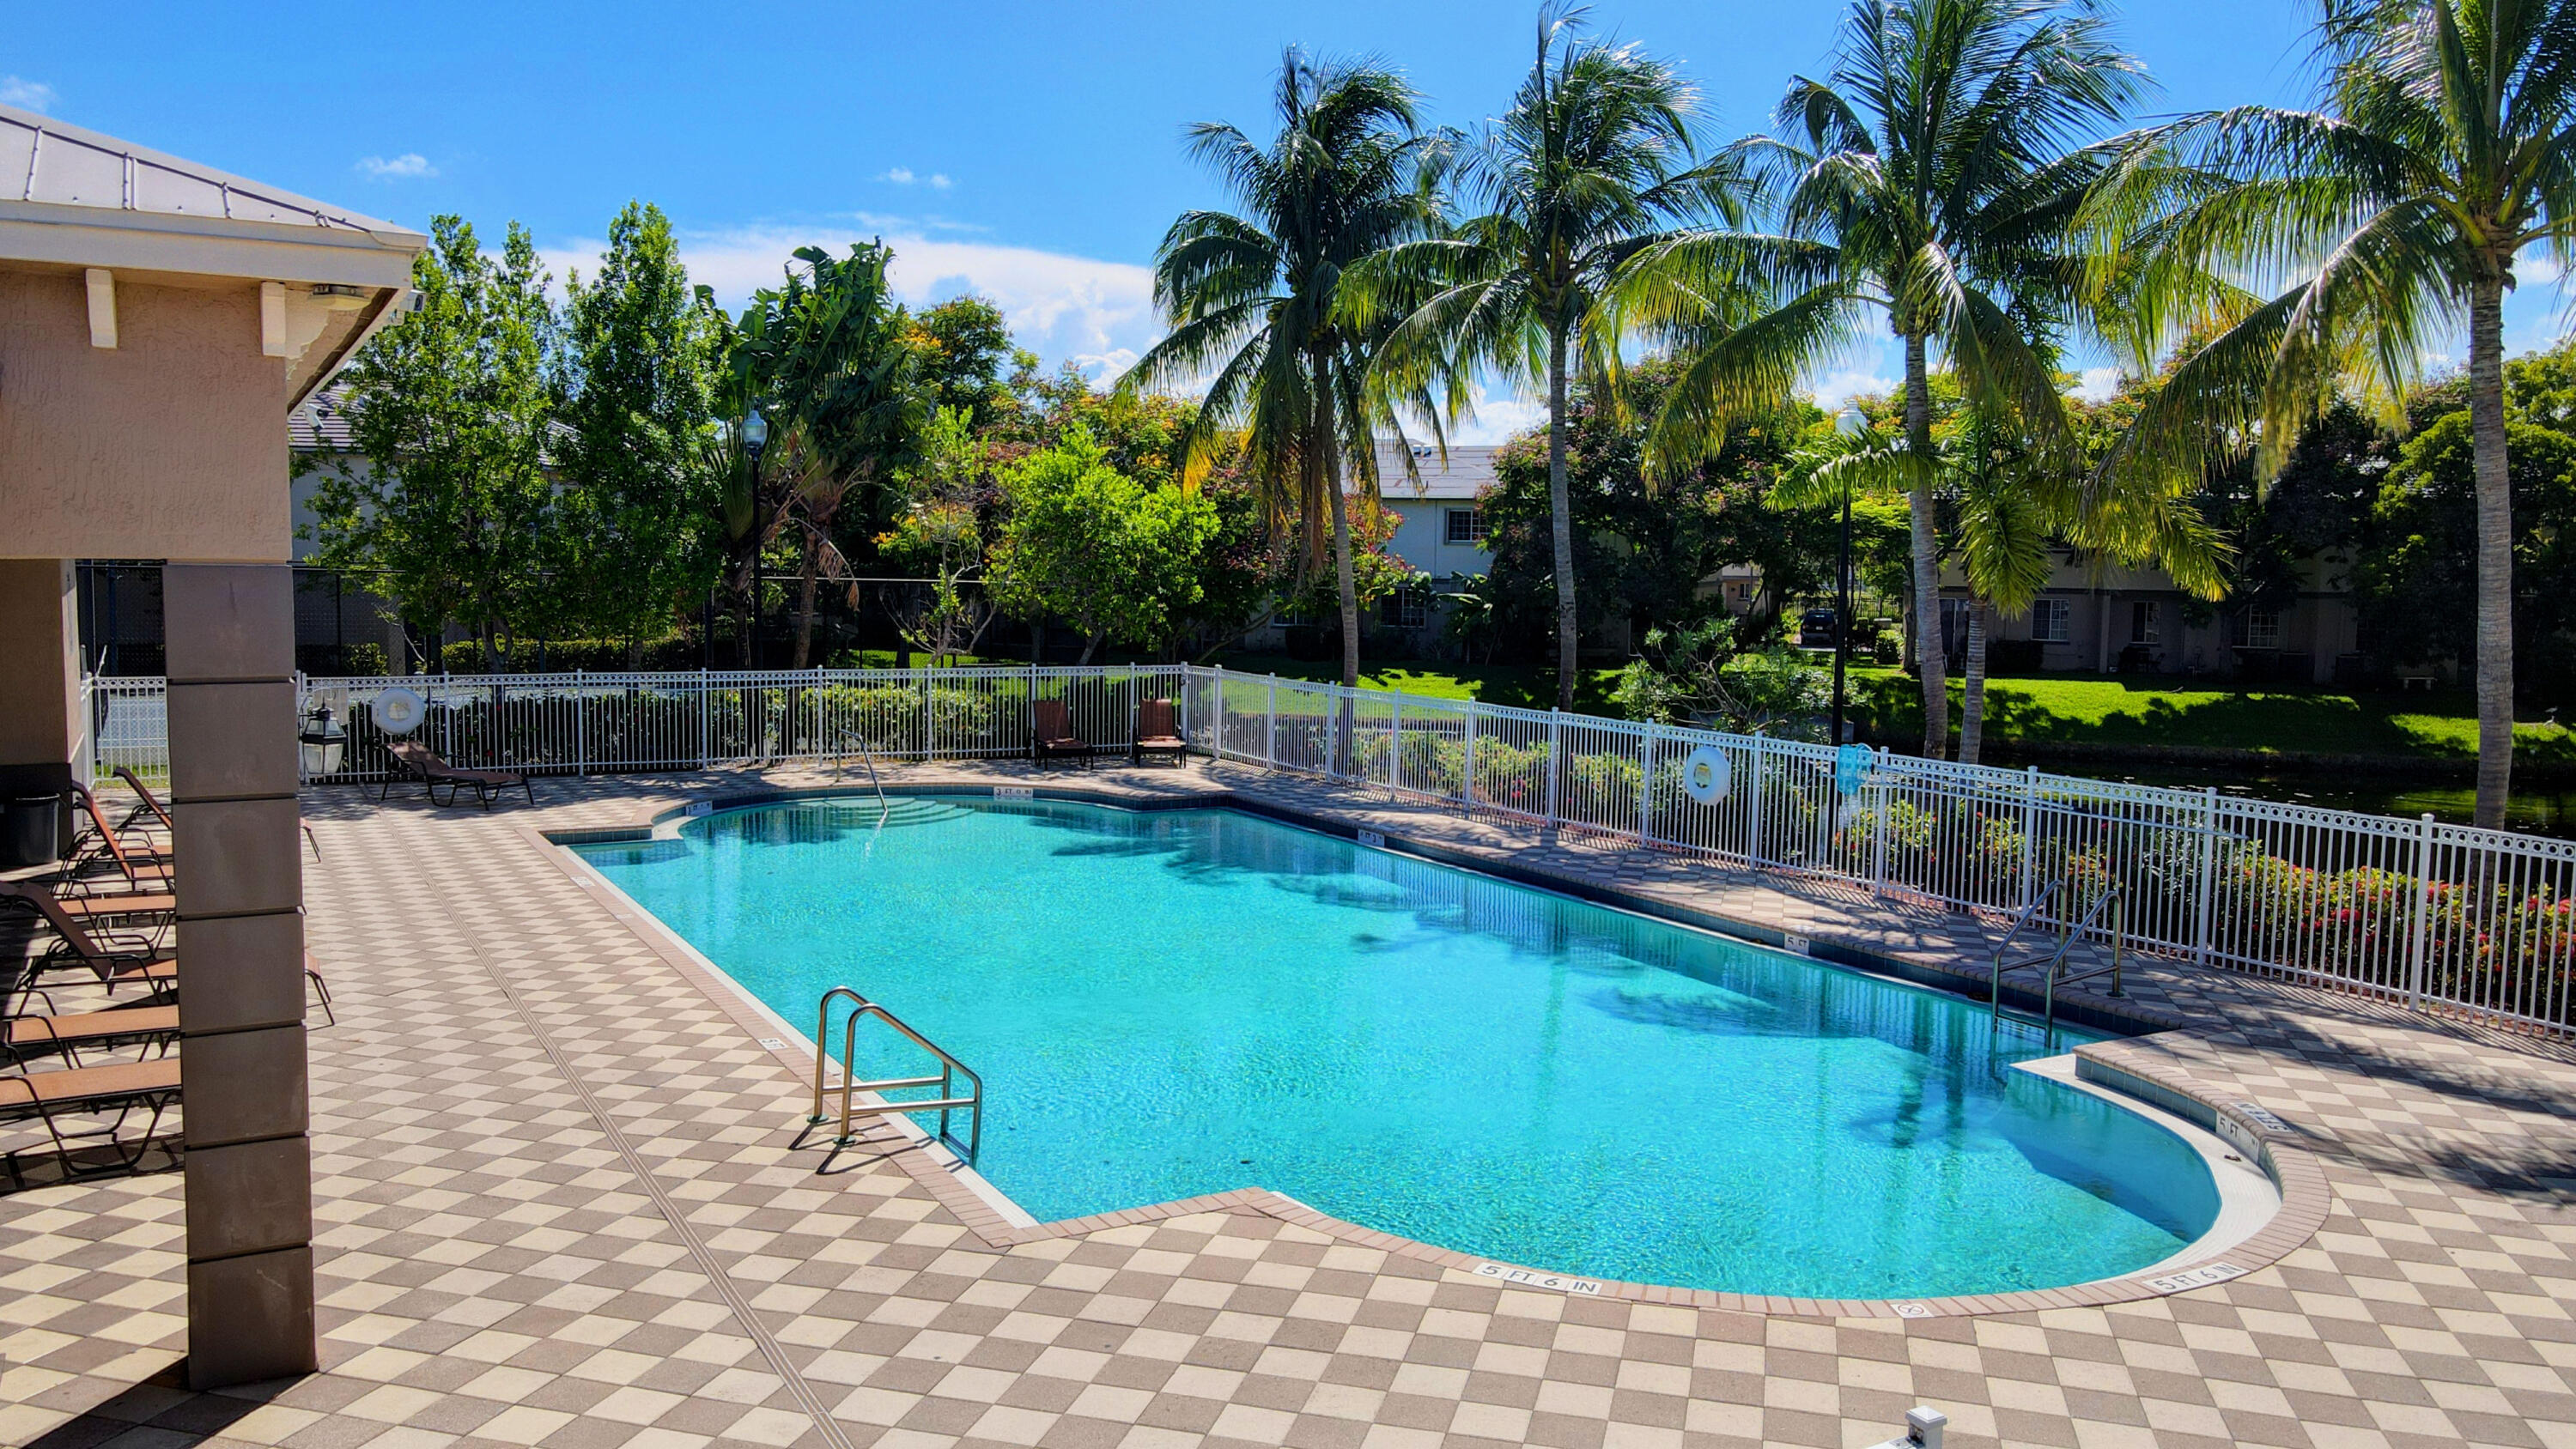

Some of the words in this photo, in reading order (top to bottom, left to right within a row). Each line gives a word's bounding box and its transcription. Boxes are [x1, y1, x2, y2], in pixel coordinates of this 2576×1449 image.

[1482, 1265, 1502, 1275] 5
[1509, 1270, 1535, 1281] FT
[1572, 1282, 1596, 1292] IN
[2154, 1280, 2177, 1290] 5
[2171, 1275, 2200, 1286] FT
[2200, 1270, 2219, 1279] 6
[2212, 1264, 2243, 1275] IN
